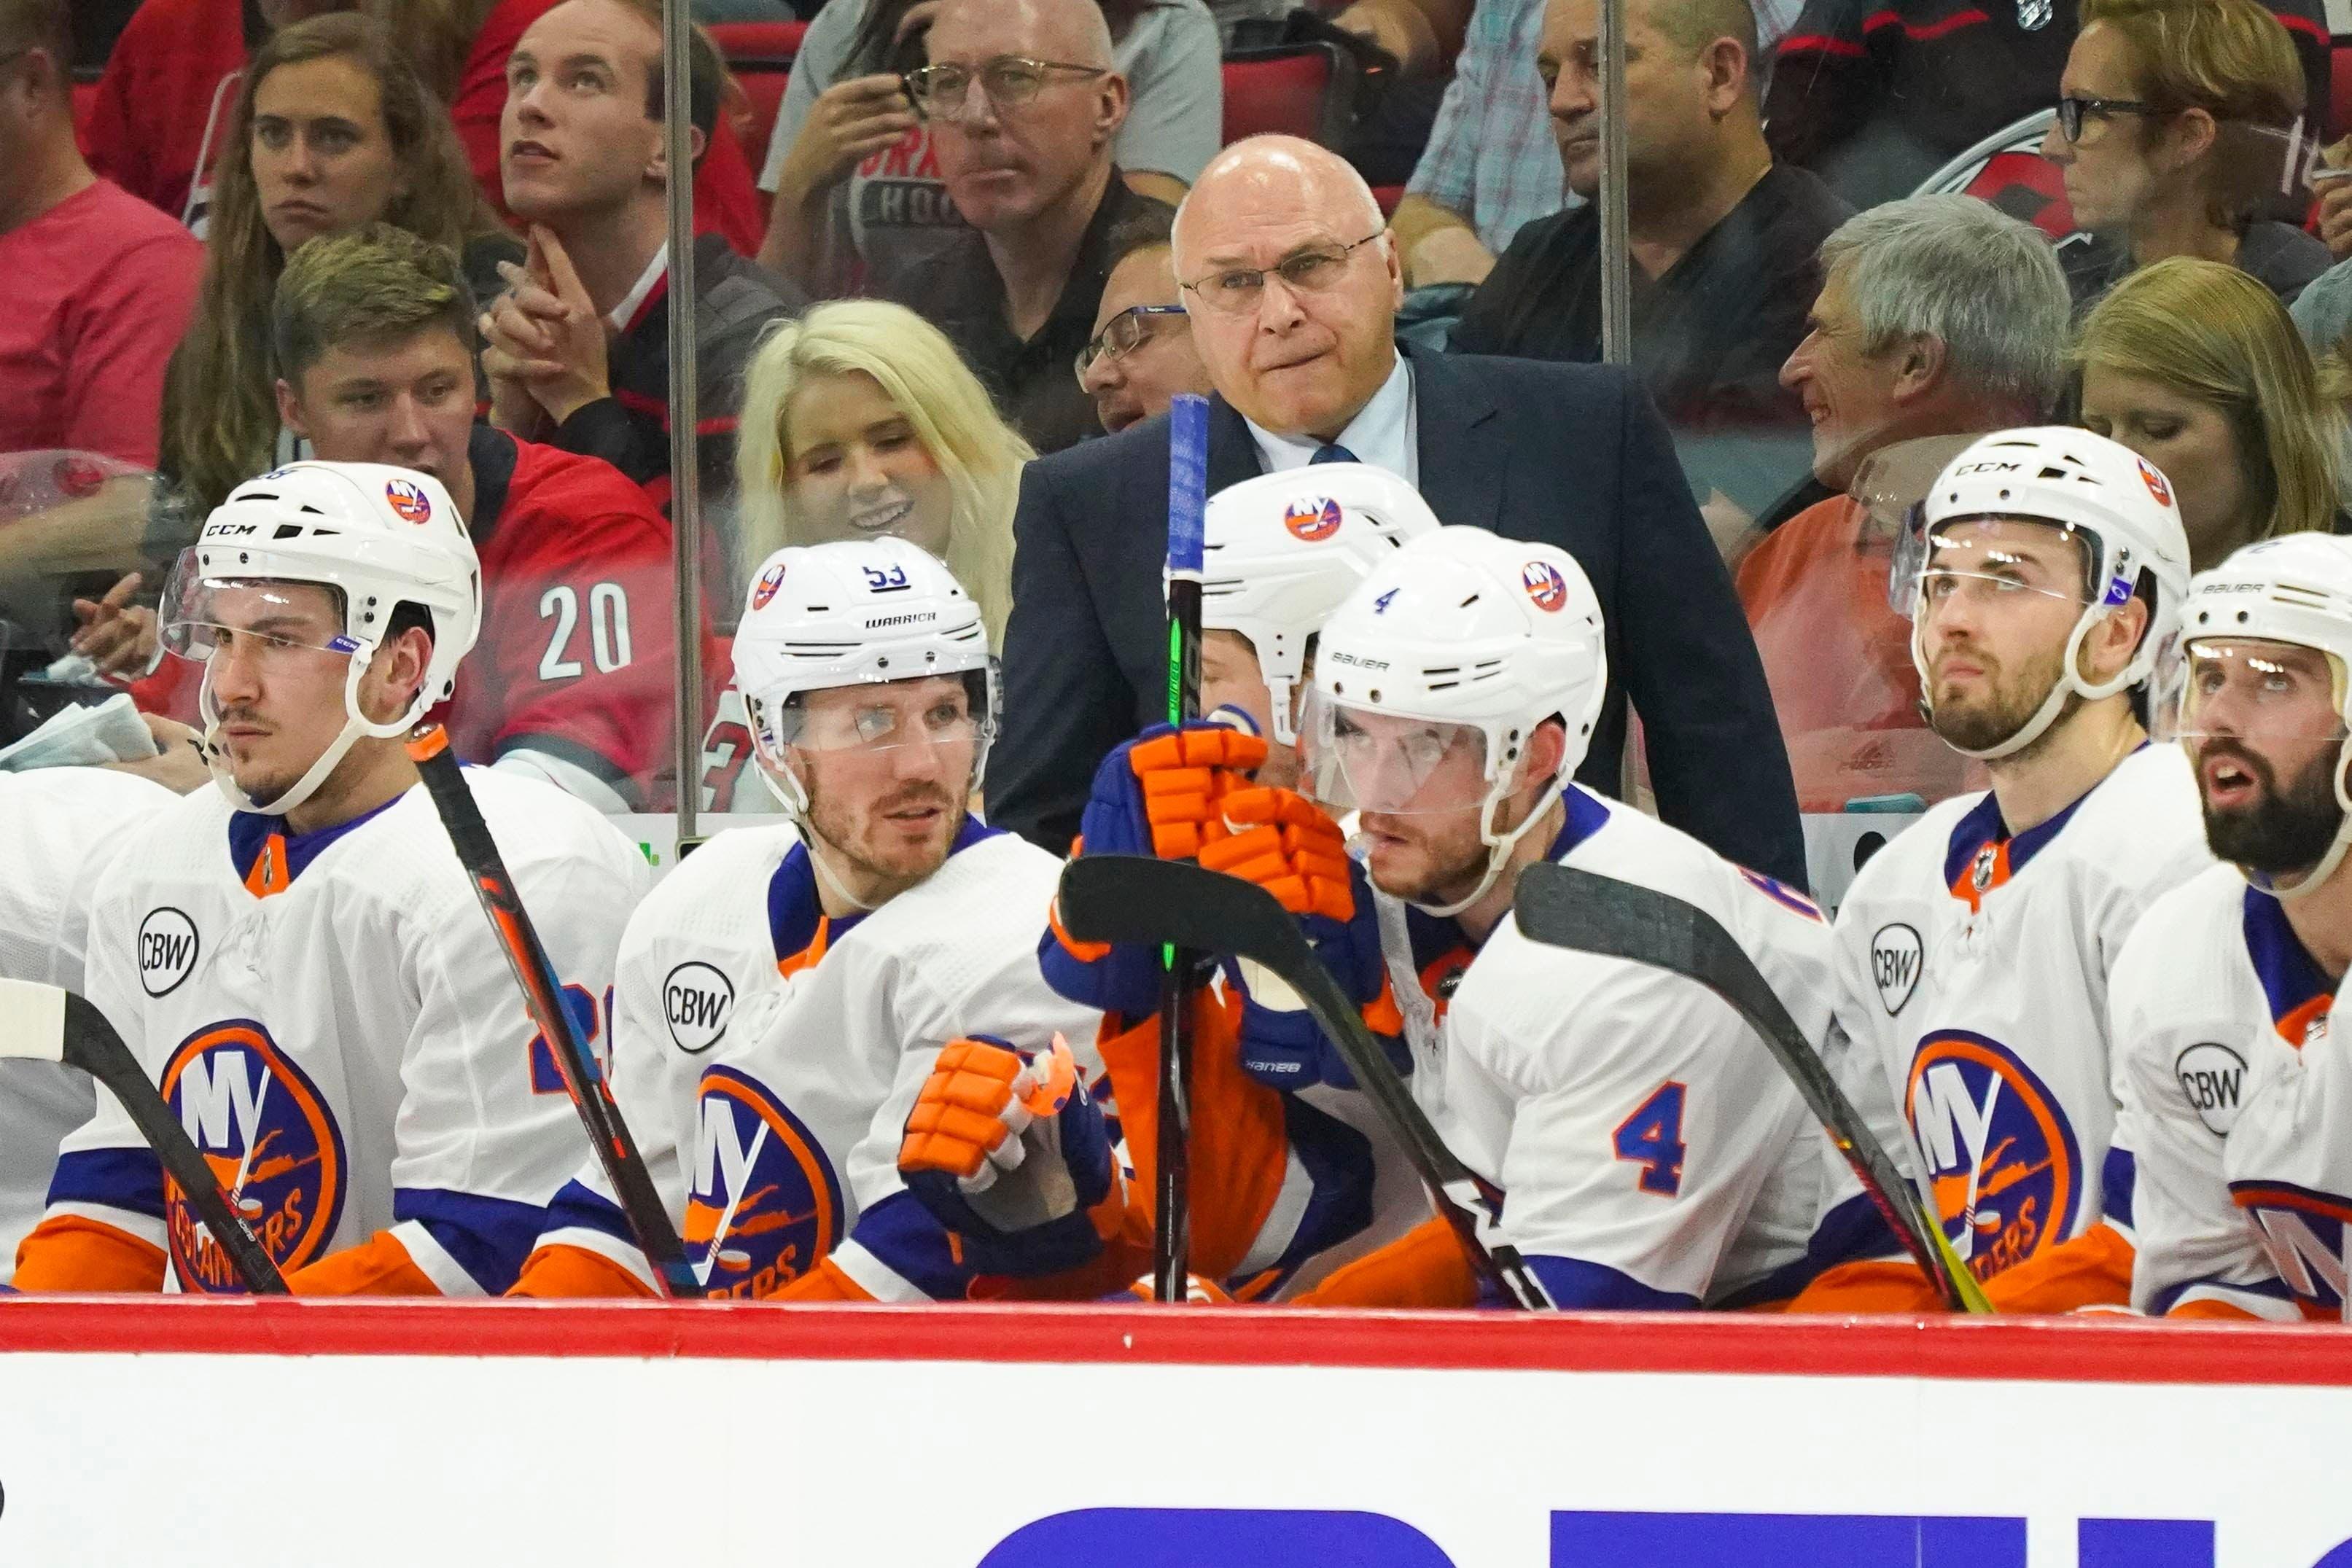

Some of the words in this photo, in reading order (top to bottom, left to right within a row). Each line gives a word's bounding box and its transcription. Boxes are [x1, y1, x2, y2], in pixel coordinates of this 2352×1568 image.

[1955, 462, 2022, 476] CCM
[206, 525, 257, 537] CCM
[1374, 588, 1401, 615] 4
[2203, 583, 2265, 594] BAUER
[538, 582, 633, 681] 20
[1332, 652, 1390, 671] BAUER
[142, 932, 192, 971] CBW
[1875, 948, 1918, 988] CBW
[669, 986, 728, 1029] CBW
[2181, 1068, 2240, 1110] CBW
[1611, 1080, 1688, 1198] 4
